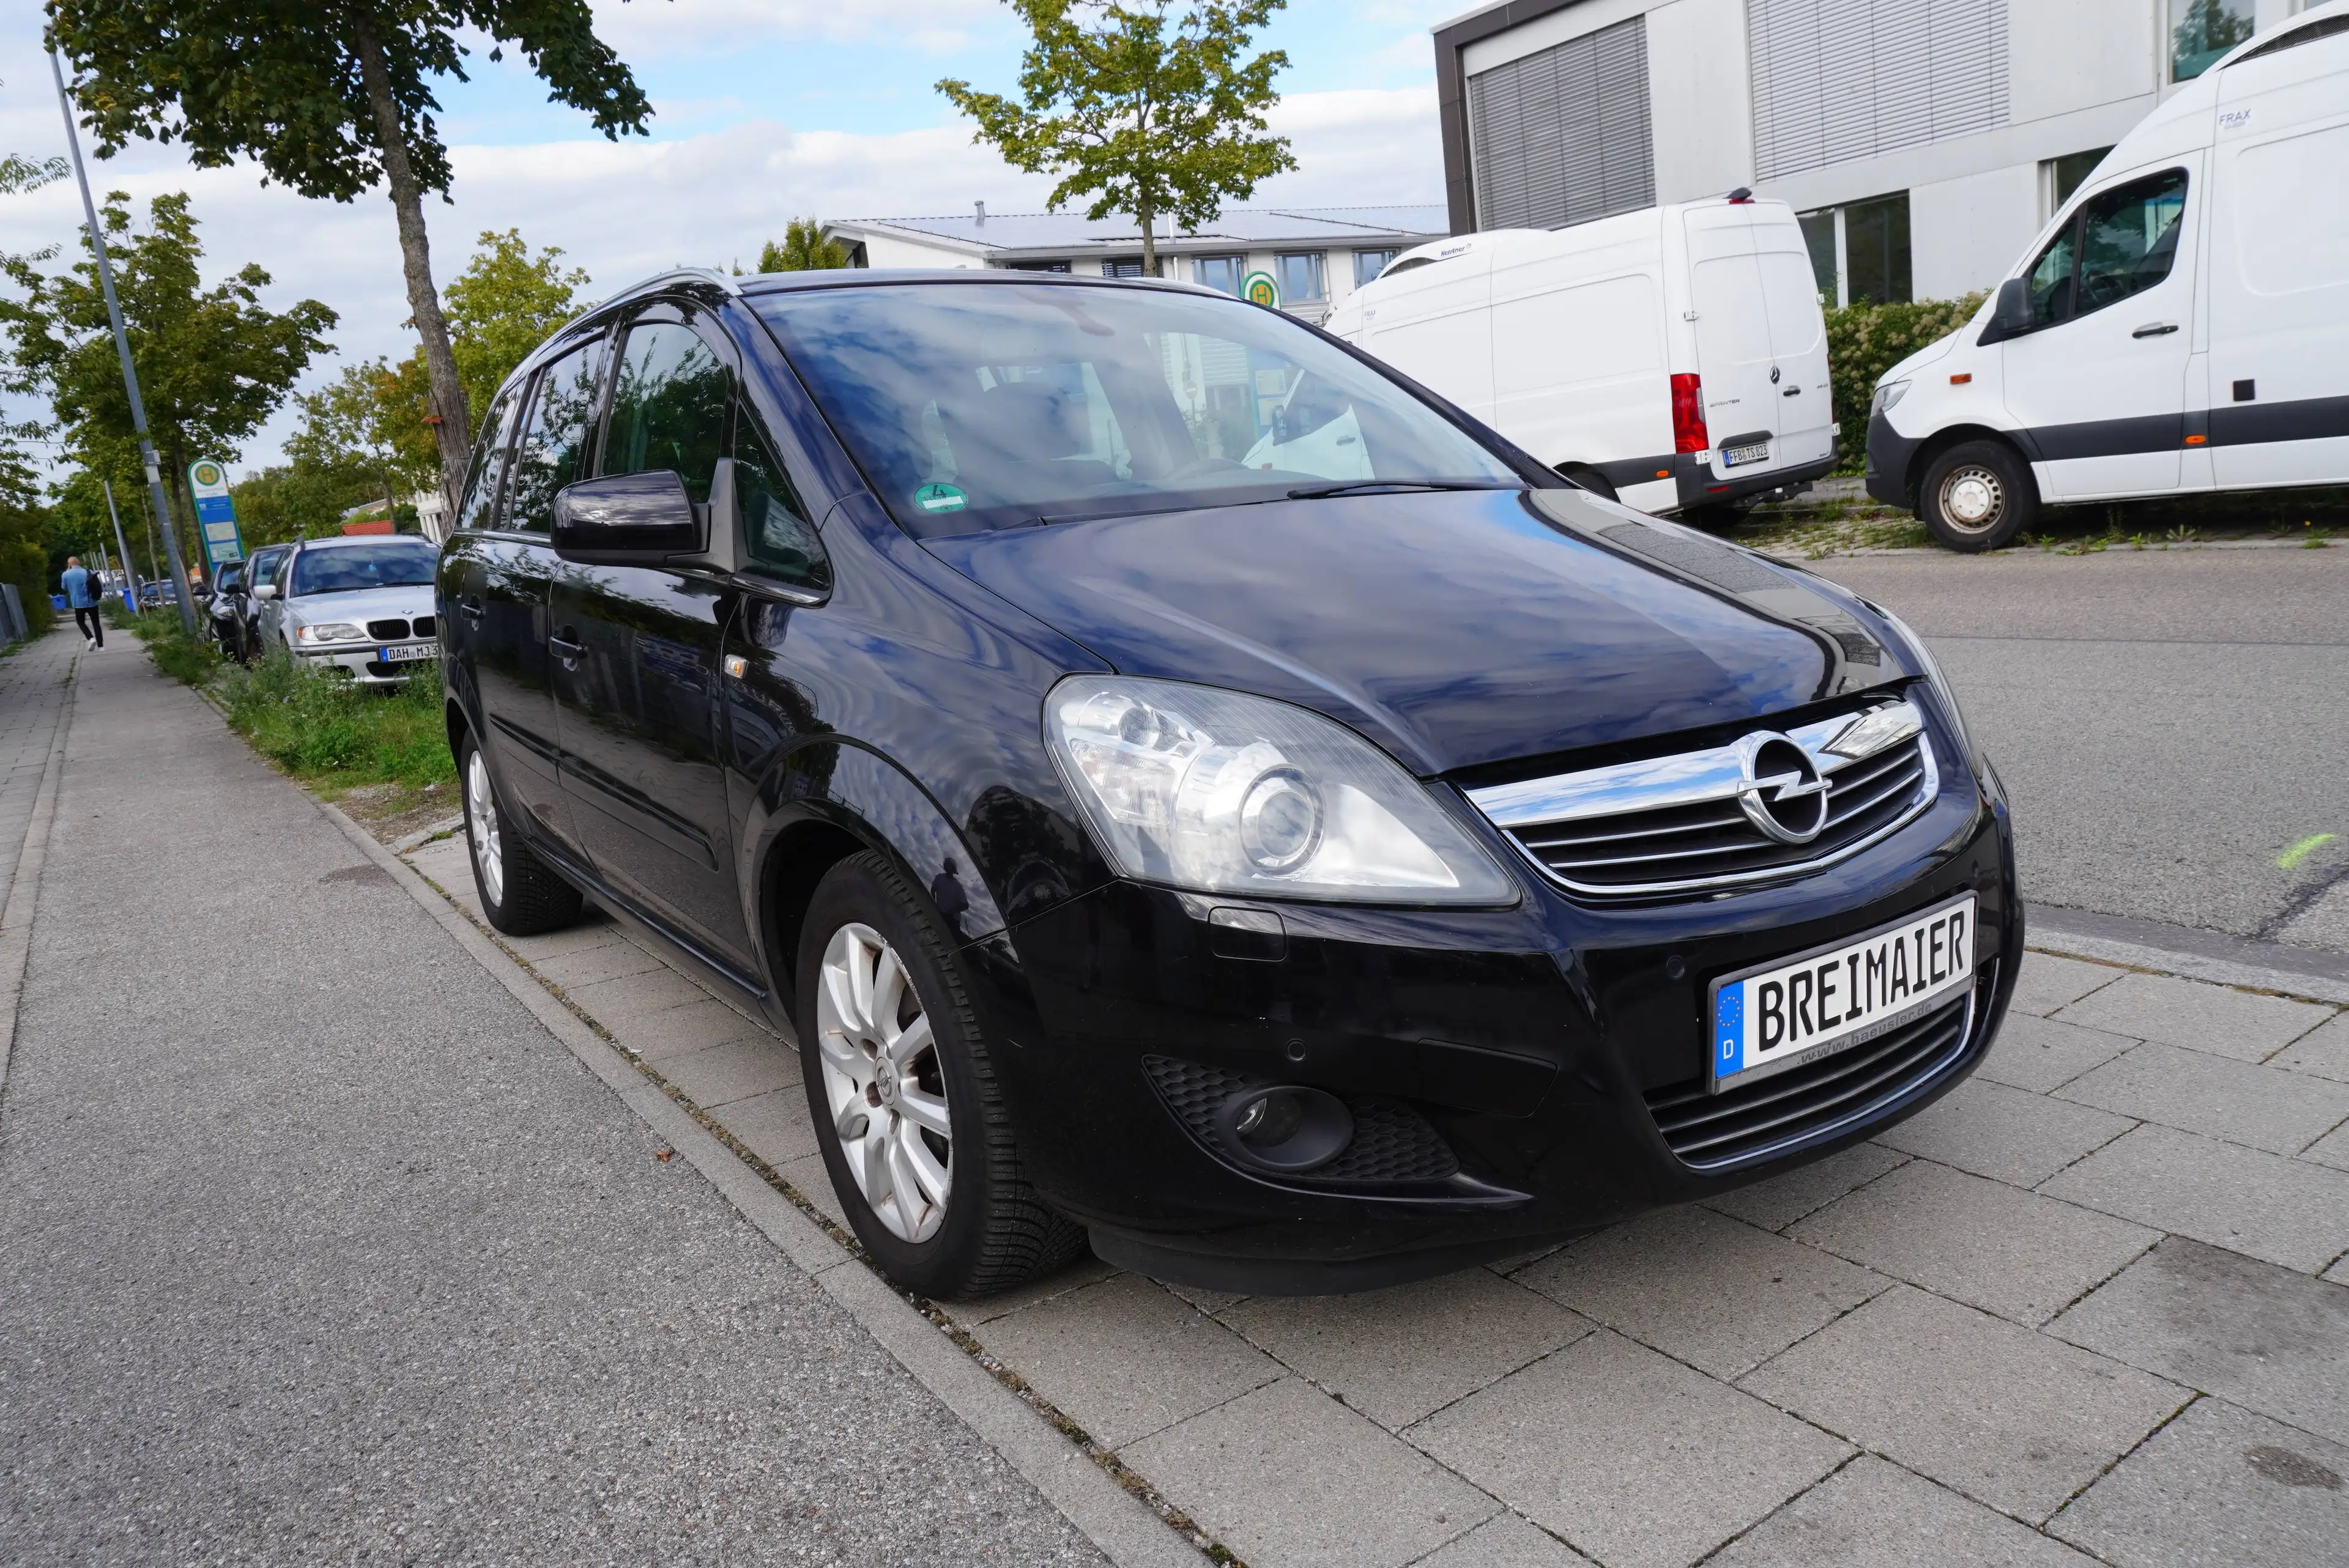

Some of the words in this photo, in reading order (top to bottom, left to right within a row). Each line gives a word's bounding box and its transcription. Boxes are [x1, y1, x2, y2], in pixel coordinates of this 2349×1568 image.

[2219, 108, 2252, 126] FRAX
[1710, 399, 1740, 408] SPRINTER
[1729, 449, 1742, 462] FFB
[1746, 448, 1754, 460] TS
[1756, 445, 1768, 456] 823
[932, 484, 947, 498] 4
[388, 648, 409, 659] DAH
[1759, 911, 1964, 1052] BREIMAIER
[1801, 1002, 1932, 1064] www.haeusler.de
[1723, 1038, 1734, 1060] D
